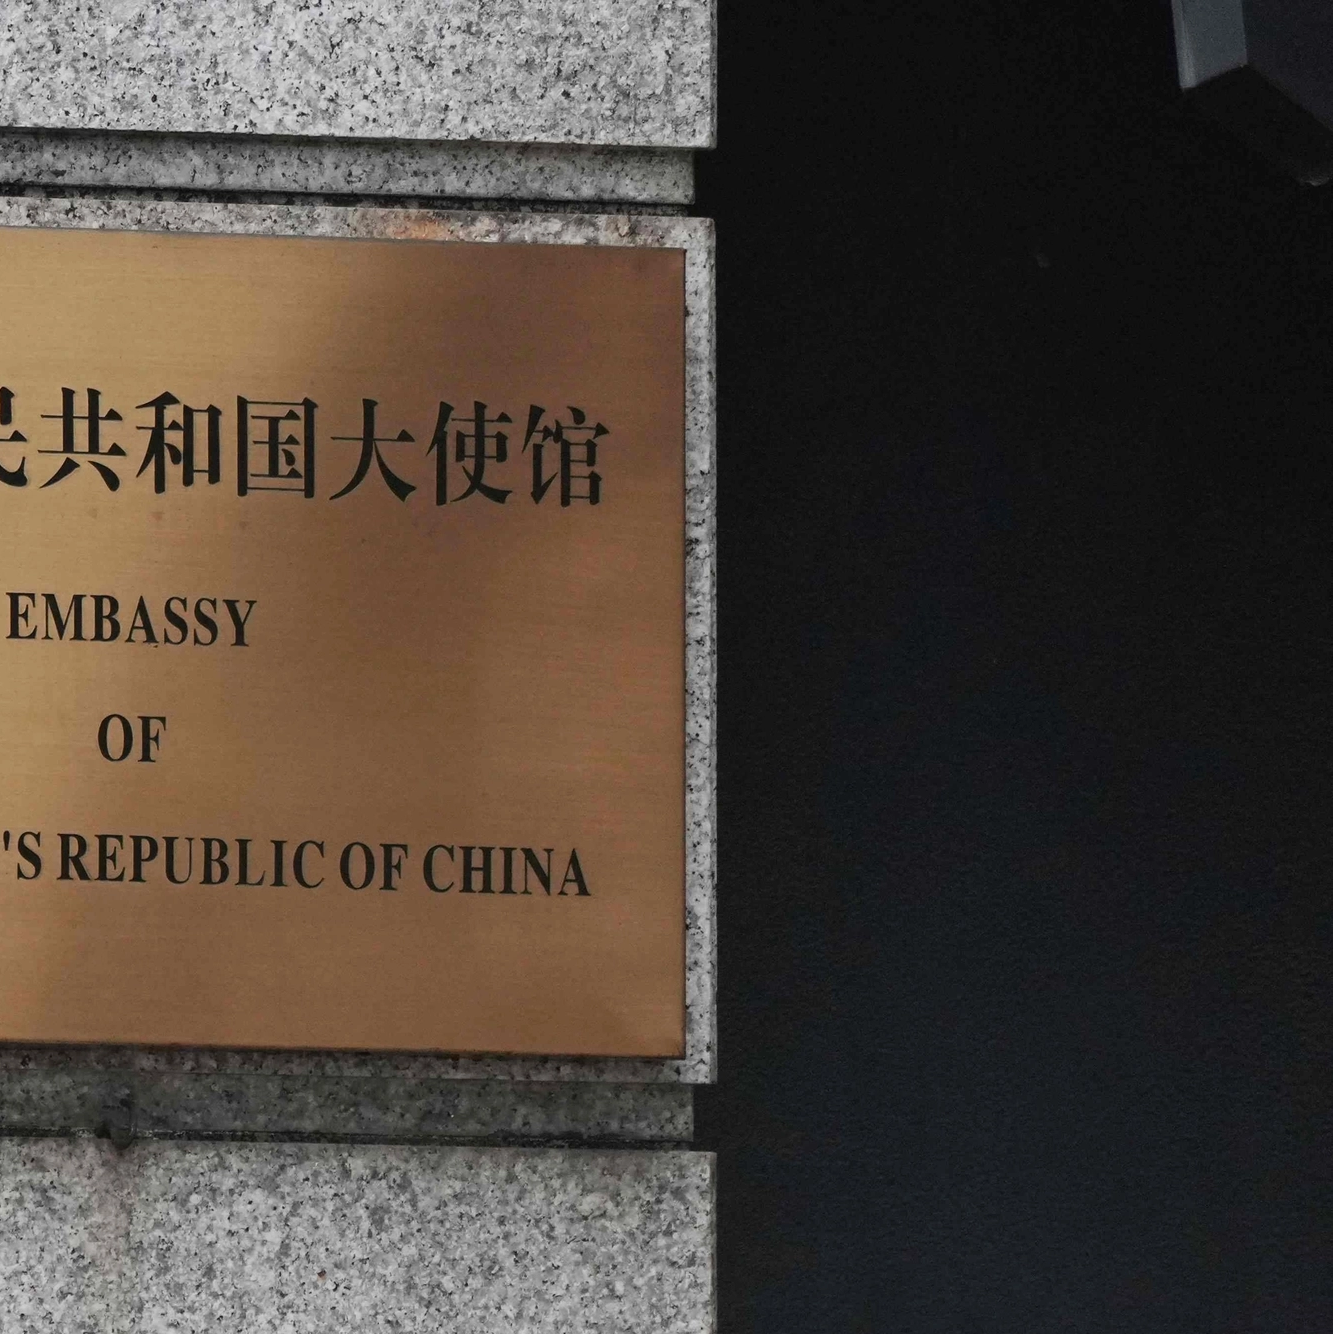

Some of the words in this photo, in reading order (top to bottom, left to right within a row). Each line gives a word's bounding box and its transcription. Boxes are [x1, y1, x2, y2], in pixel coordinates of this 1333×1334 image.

[5, 591, 258, 647] EMBASSY
[97, 713, 167, 763] OF
[56, 832, 325, 889] REPUBLIC
[339, 841, 409, 892] OF
[422, 844, 592, 897] CHINA
